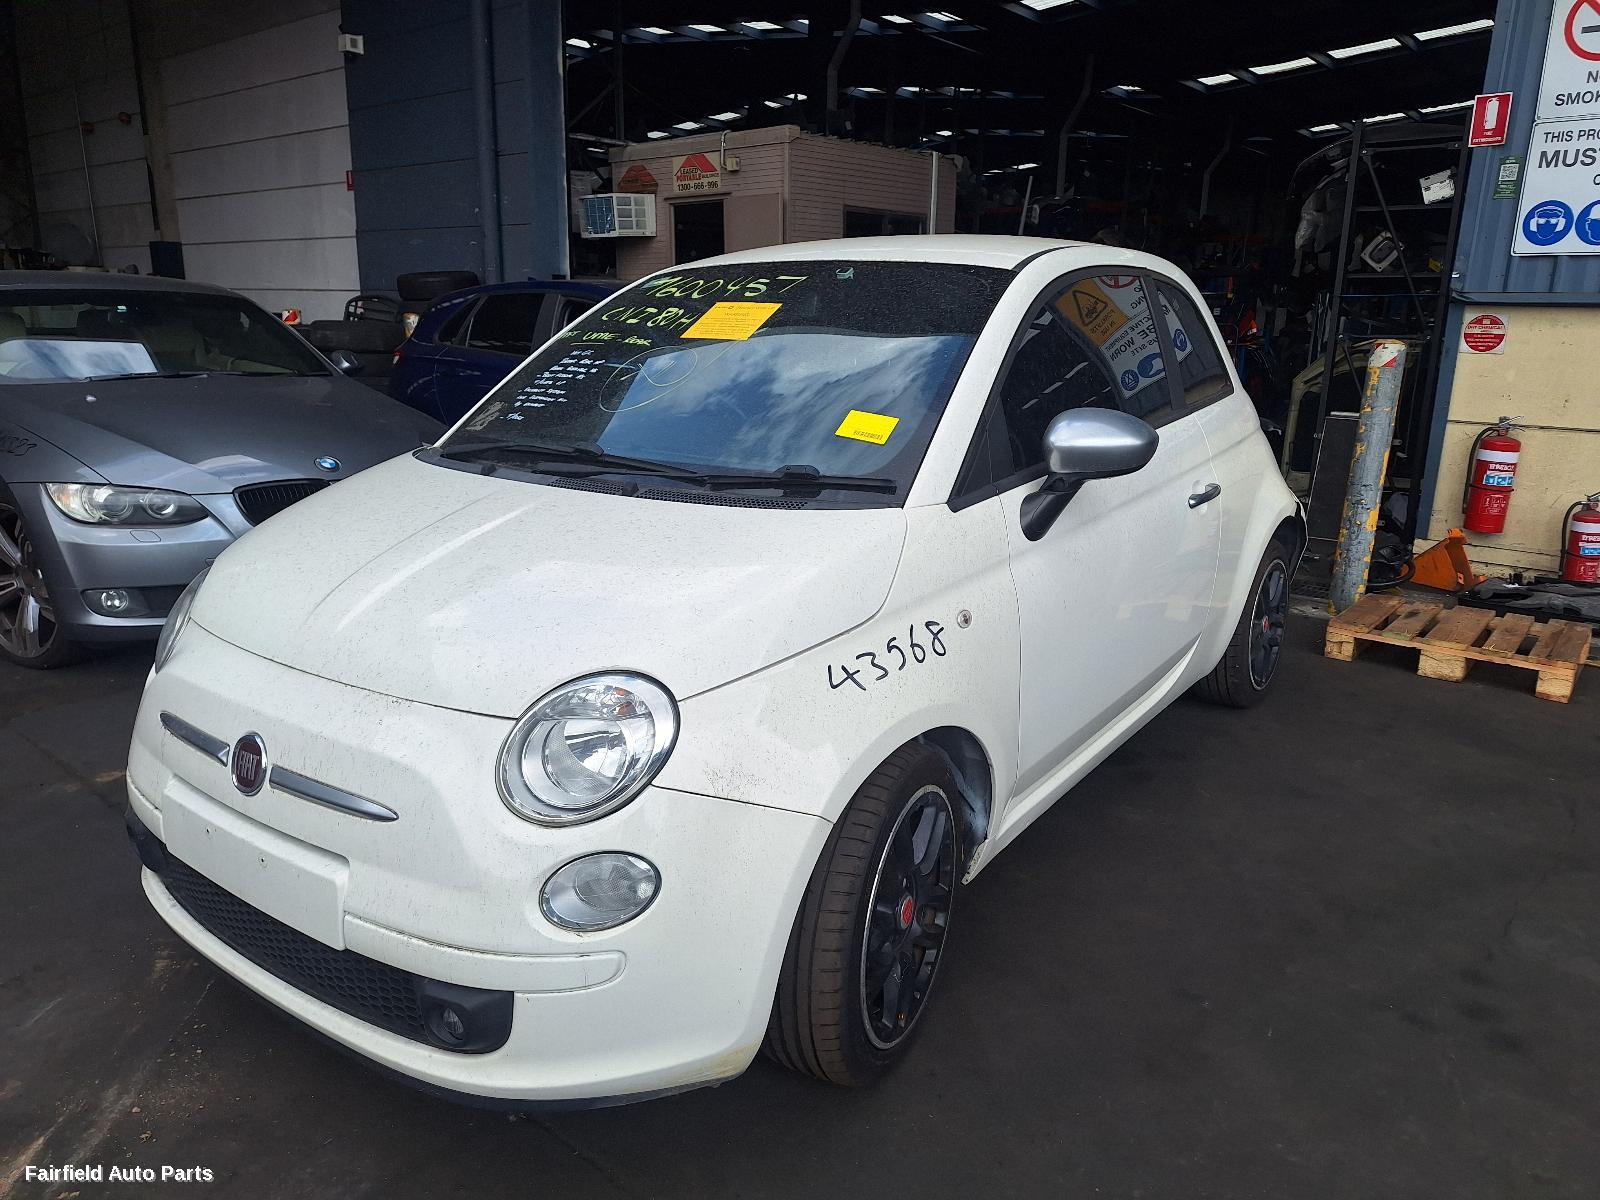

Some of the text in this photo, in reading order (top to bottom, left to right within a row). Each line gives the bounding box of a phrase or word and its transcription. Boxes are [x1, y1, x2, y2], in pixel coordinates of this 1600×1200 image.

[1586, 70, 1600, 84] N
[1543, 130, 1573, 144] THIS
[1538, 147, 1600, 169] MUS
[676, 173, 702, 182] PORTABLE
[680, 167, 698, 175] LEASED
[827, 620, 947, 691] 43568
[238, 750, 260, 781] FIAT
